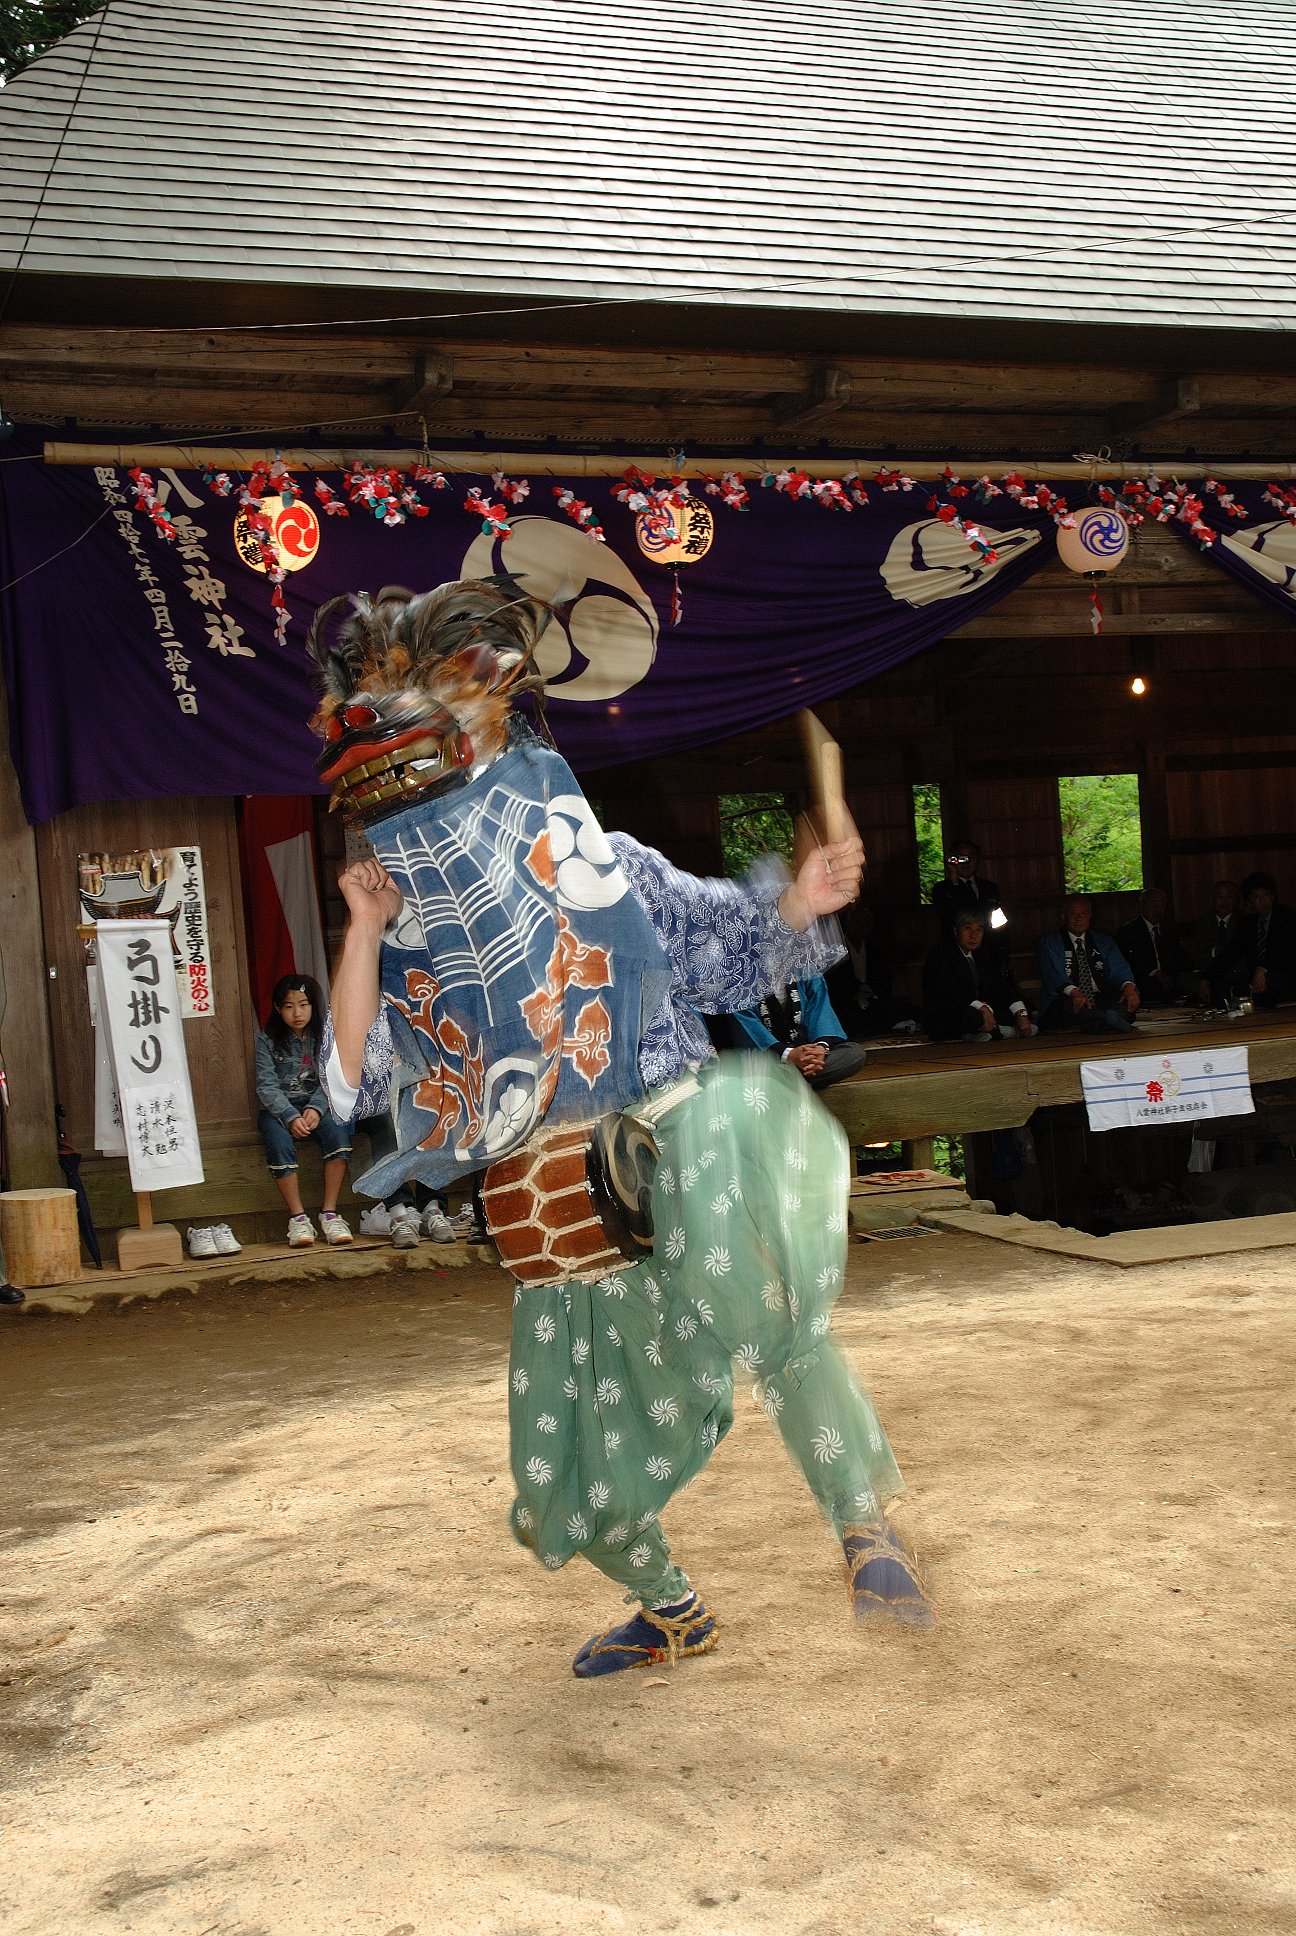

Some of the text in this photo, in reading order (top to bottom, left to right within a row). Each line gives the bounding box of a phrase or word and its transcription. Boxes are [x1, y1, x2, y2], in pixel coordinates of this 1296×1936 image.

[155, 467, 257, 658] 八雲神社
[180, 851, 210, 1012] 育てよう歴史を守る防火の心
[127, 938, 170, 1074] 弓掛り
[1146, 1080, 1164, 1103] 祭
